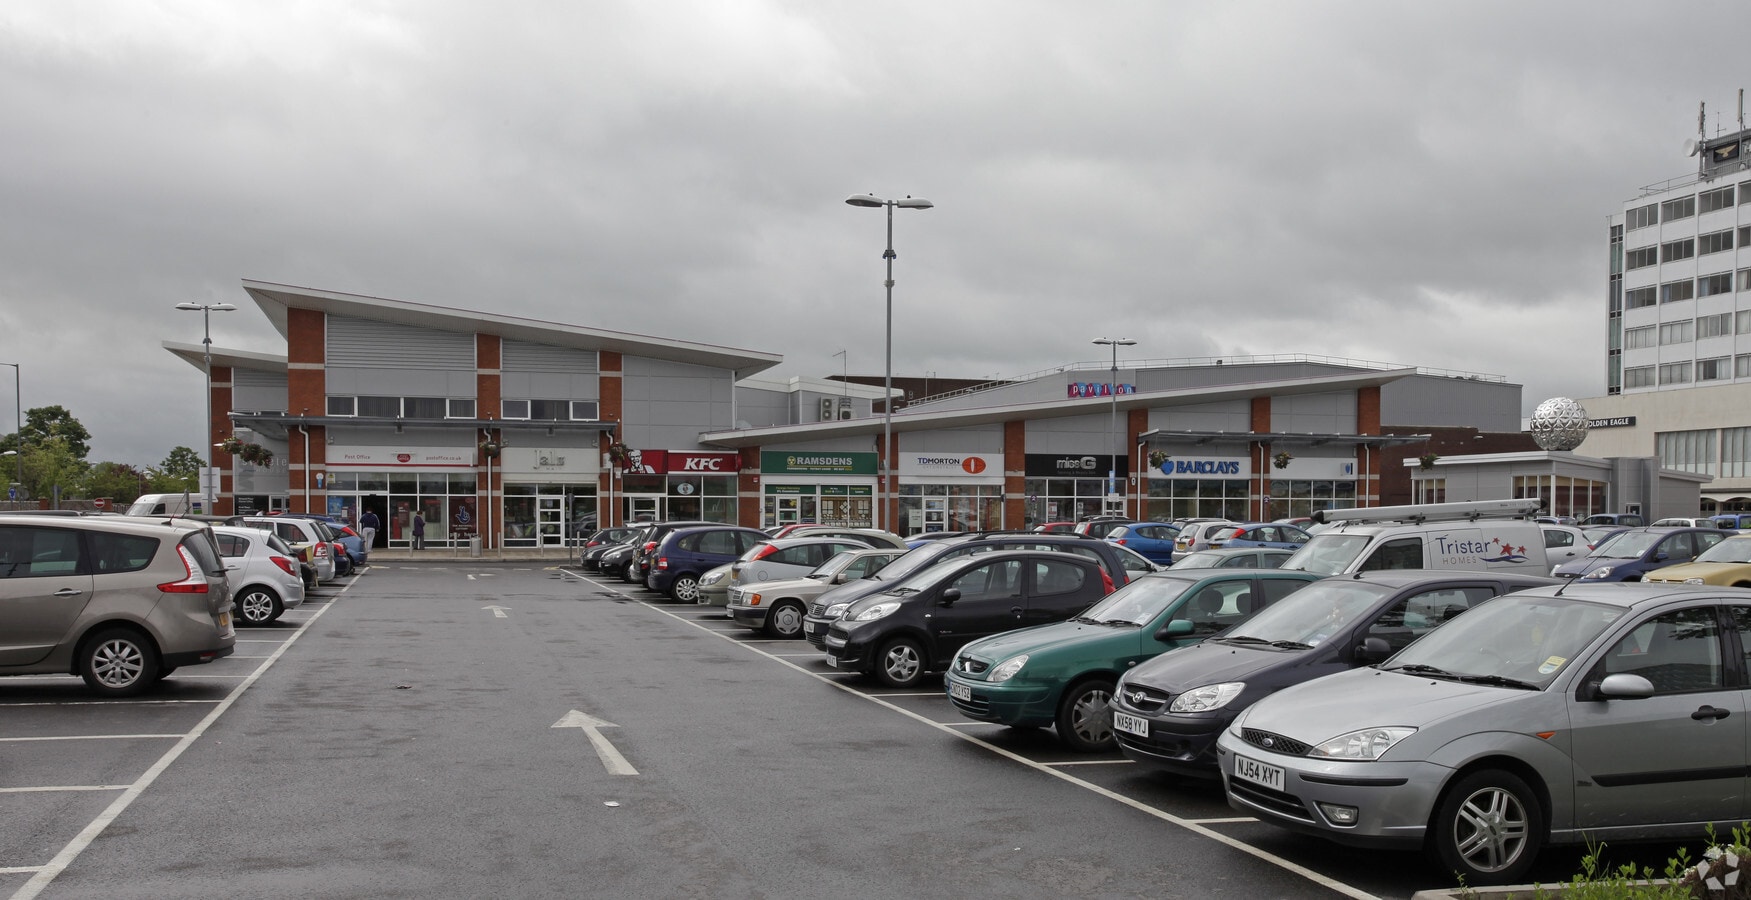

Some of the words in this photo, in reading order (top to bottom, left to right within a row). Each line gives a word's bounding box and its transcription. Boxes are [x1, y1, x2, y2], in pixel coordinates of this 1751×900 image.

[1589, 419, 1608, 428] OLDEN
[1610, 418, 1630, 426] EAGLE
[683, 458, 721, 471] KFC
[796, 456, 853, 466] RAMSDENS
[1176, 460, 1240, 475] BARCLAYS
[1435, 536, 1491, 555] Tristar
[1442, 556, 1477, 565] HOMES
[1116, 714, 1133, 730] NX58
[1134, 718, 1147, 734] YYJ
[1238, 758, 1260, 780] NJ54
[1262, 765, 1281, 787] XYT
